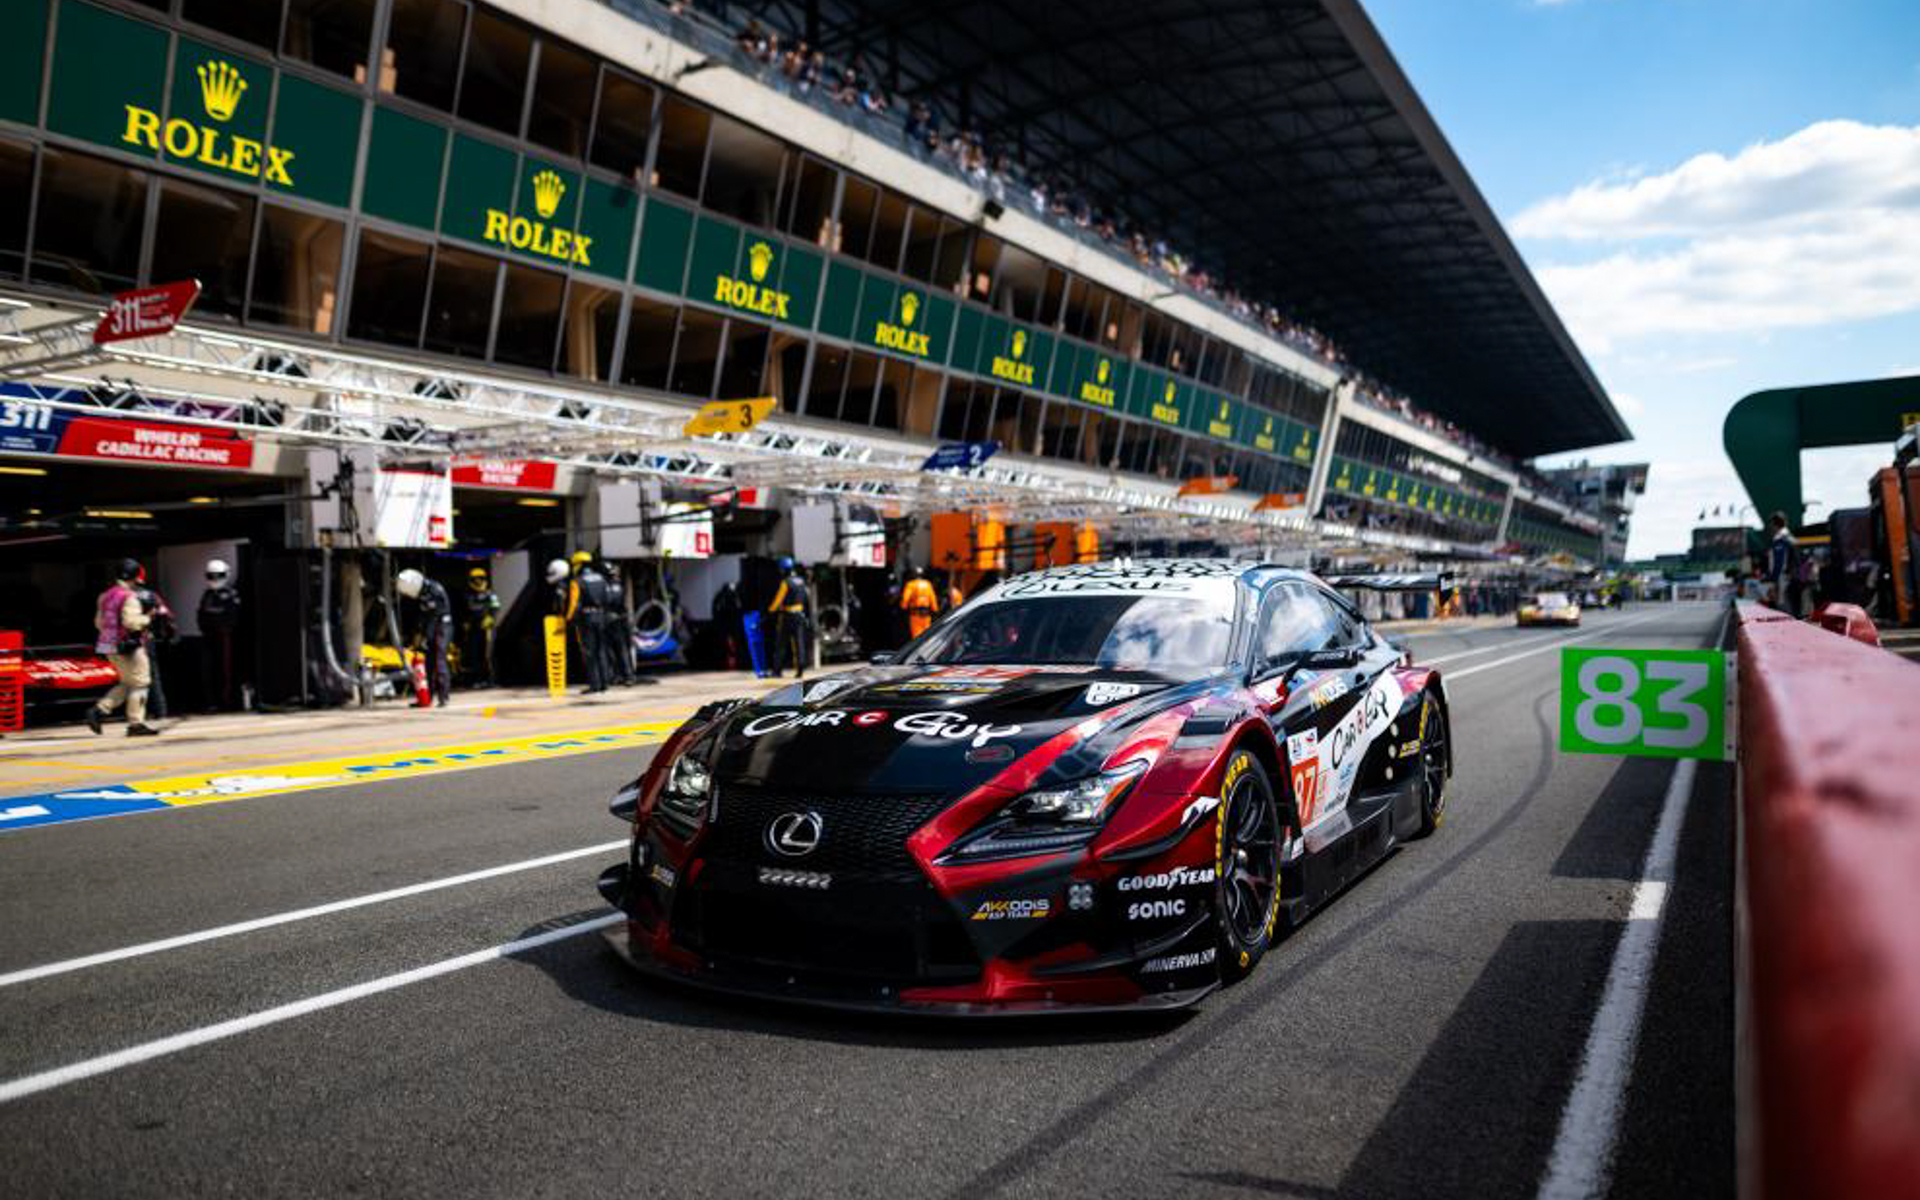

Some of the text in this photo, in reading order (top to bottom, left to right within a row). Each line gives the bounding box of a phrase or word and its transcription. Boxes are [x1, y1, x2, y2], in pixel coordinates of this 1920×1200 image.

[123, 105, 293, 186] ROLEX
[483, 208, 592, 266] ROLEX
[714, 275, 790, 319] ROLEX
[110, 298, 140, 333] 311
[875, 322, 931, 356] ROLEX
[740, 404, 753, 428] 3
[134, 428, 201, 446] WHELEN
[96, 441, 230, 464] CADILLAC RACING
[969, 445, 982, 466] 2
[1050, 580, 1191, 592] LEXUS
[1574, 656, 1710, 749] 83
[1118, 866, 1215, 891] GOODYEAR
[979, 899, 1050, 913] AKKODIS
[1146, 952, 1200, 973] MINERVA
